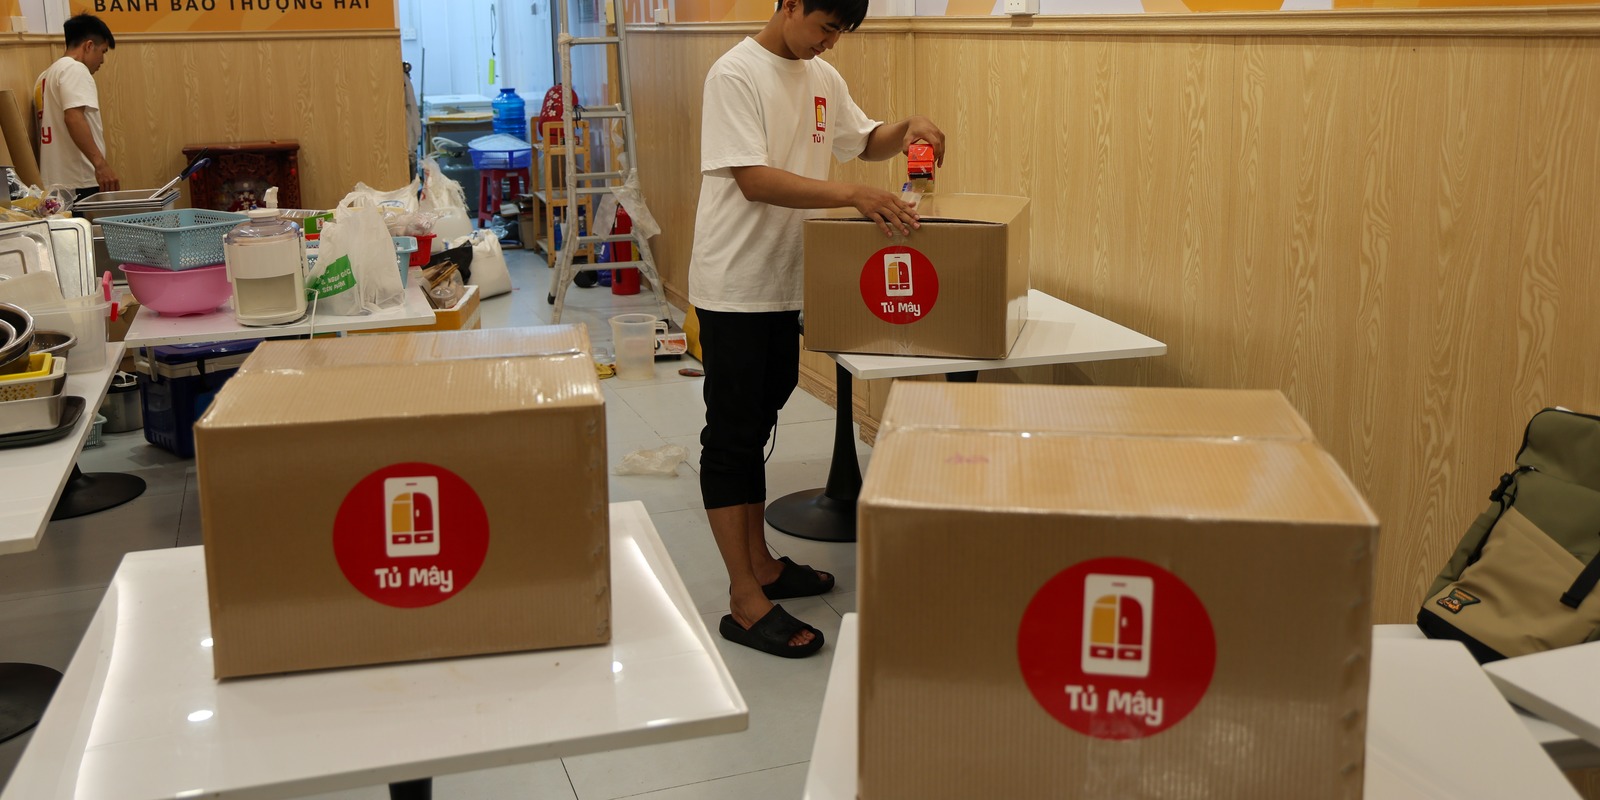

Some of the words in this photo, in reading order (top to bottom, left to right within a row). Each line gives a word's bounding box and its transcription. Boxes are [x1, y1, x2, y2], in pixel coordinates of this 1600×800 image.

[880, 301, 895, 313] Tủ
[897, 301, 921, 317] Mây
[374, 566, 402, 589] Tủ
[408, 565, 454, 593] Mây
[1064, 685, 1098, 712] Tủ
[1106, 689, 1164, 727] Mây
